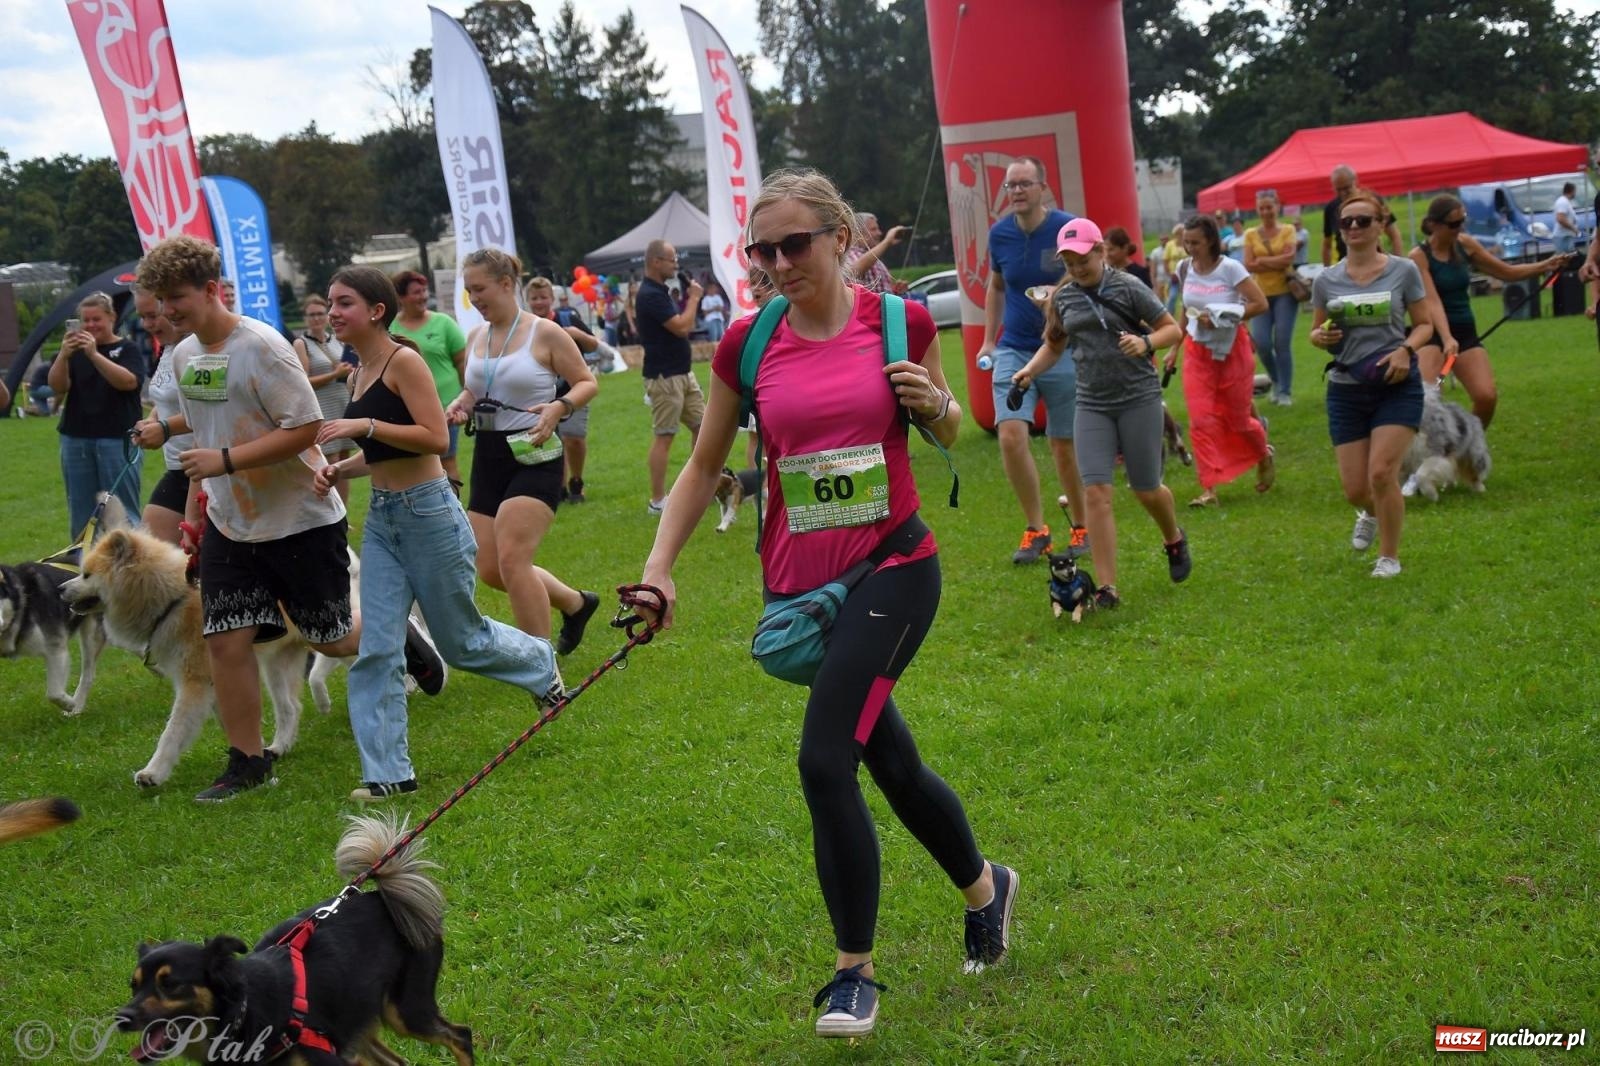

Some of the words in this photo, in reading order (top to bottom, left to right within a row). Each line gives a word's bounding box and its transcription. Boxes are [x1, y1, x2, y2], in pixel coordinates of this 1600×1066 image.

[1355, 304, 1374, 316] 13
[194, 370, 211, 385] 29
[779, 456, 816, 469] ZOO-MAR
[818, 448, 881, 463] DOGTREKKING
[814, 474, 854, 503] 60
